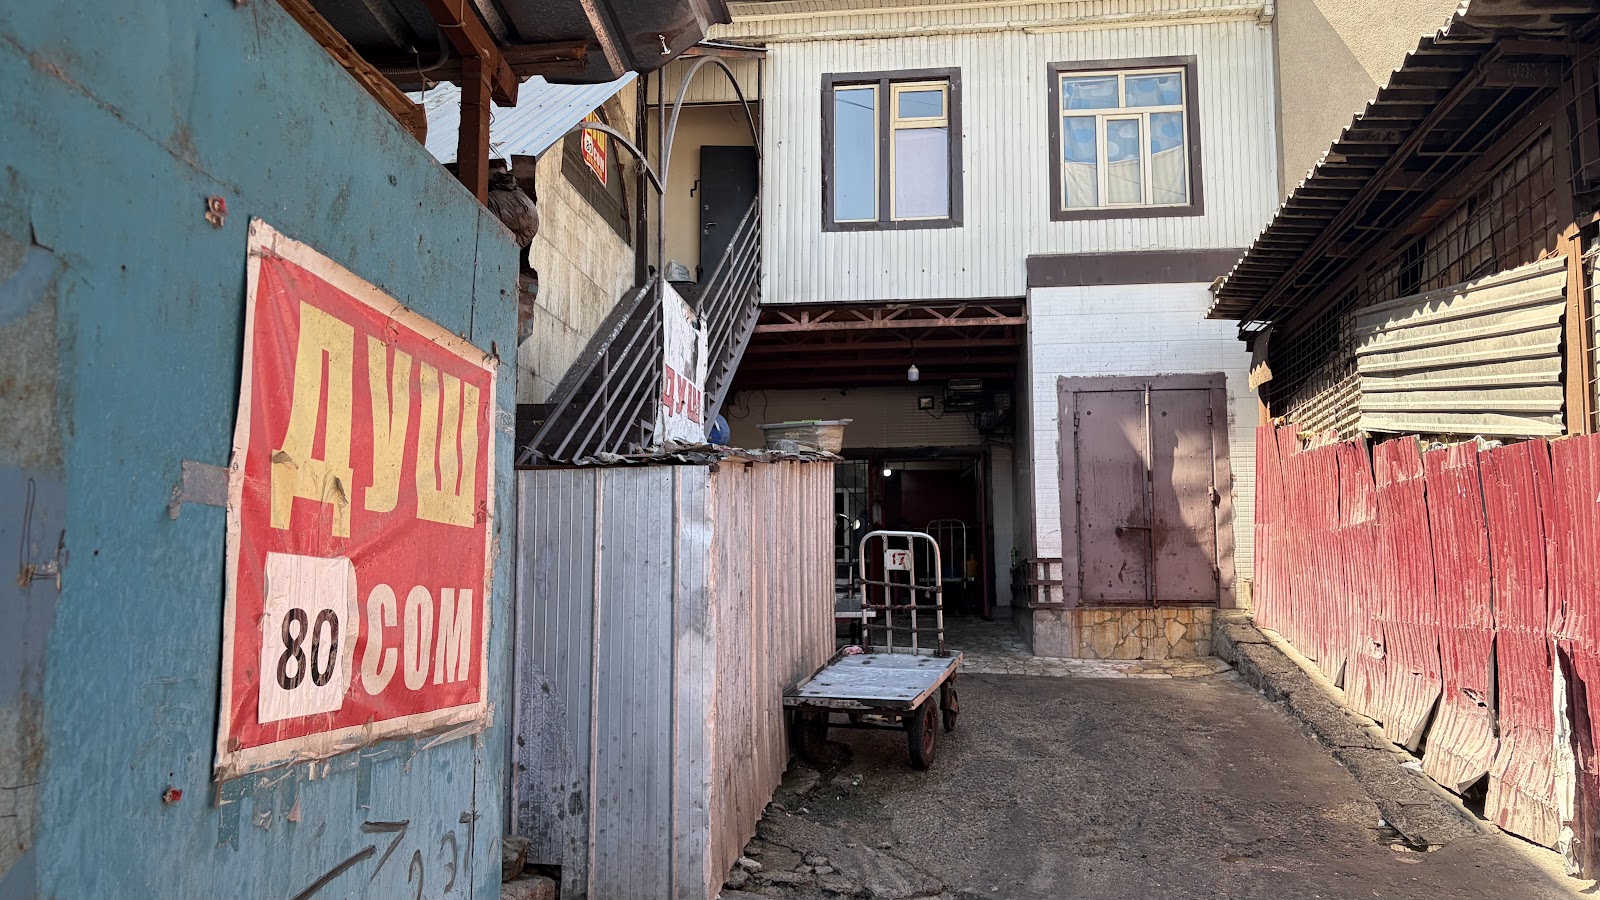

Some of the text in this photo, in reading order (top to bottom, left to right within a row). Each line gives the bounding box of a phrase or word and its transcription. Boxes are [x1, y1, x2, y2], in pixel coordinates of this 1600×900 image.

[270, 299, 480, 539] ДУШ
[663, 363, 701, 425] ДУШ
[892, 553, 906, 566] 17
[277, 583, 473, 696] 80 СОМ
